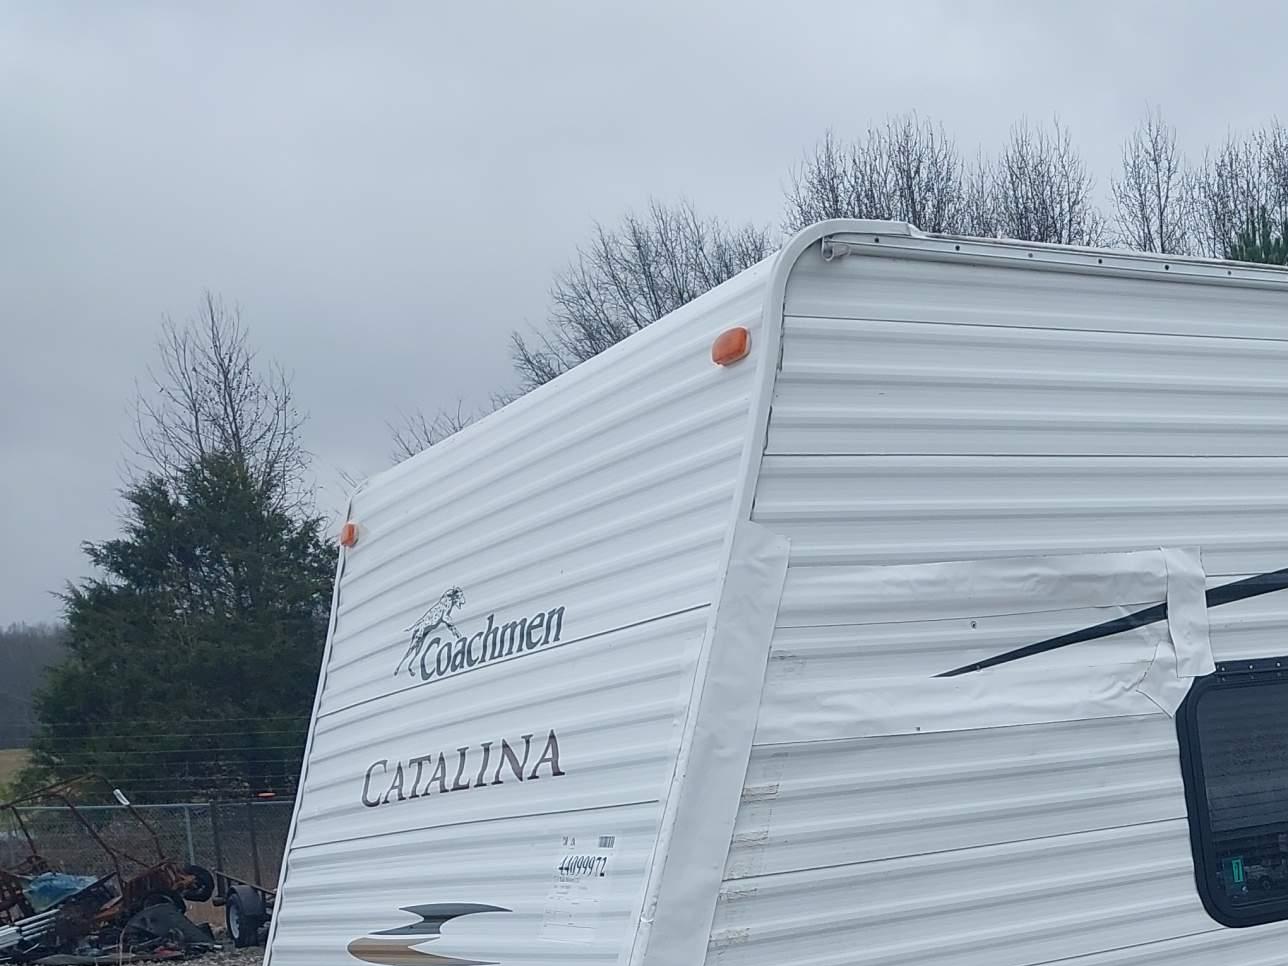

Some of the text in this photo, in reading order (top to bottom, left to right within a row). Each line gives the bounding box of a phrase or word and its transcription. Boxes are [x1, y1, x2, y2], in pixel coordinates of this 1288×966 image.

[419, 605, 566, 681] Coachmen
[361, 728, 566, 808] CATALINA
[558, 855, 608, 877] 44099972
